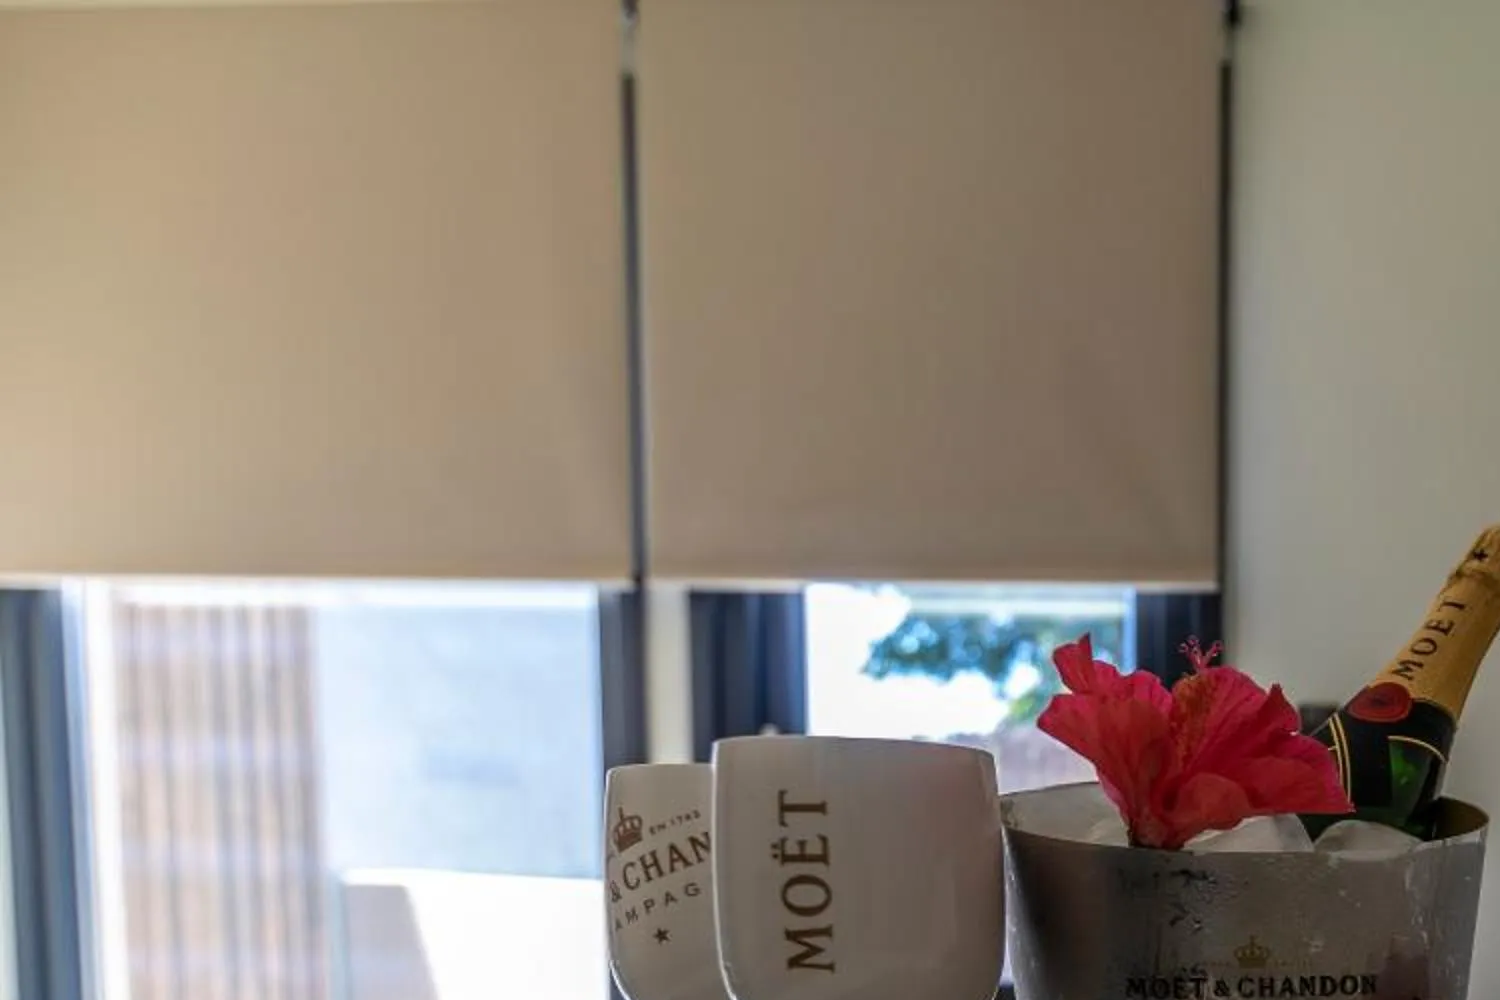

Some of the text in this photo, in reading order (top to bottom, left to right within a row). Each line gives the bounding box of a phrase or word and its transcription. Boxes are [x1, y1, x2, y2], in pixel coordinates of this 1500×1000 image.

[771, 789, 836, 974] MOËT
[1213, 980, 1232, 997] &
[1237, 974, 1378, 998] CHANDON
